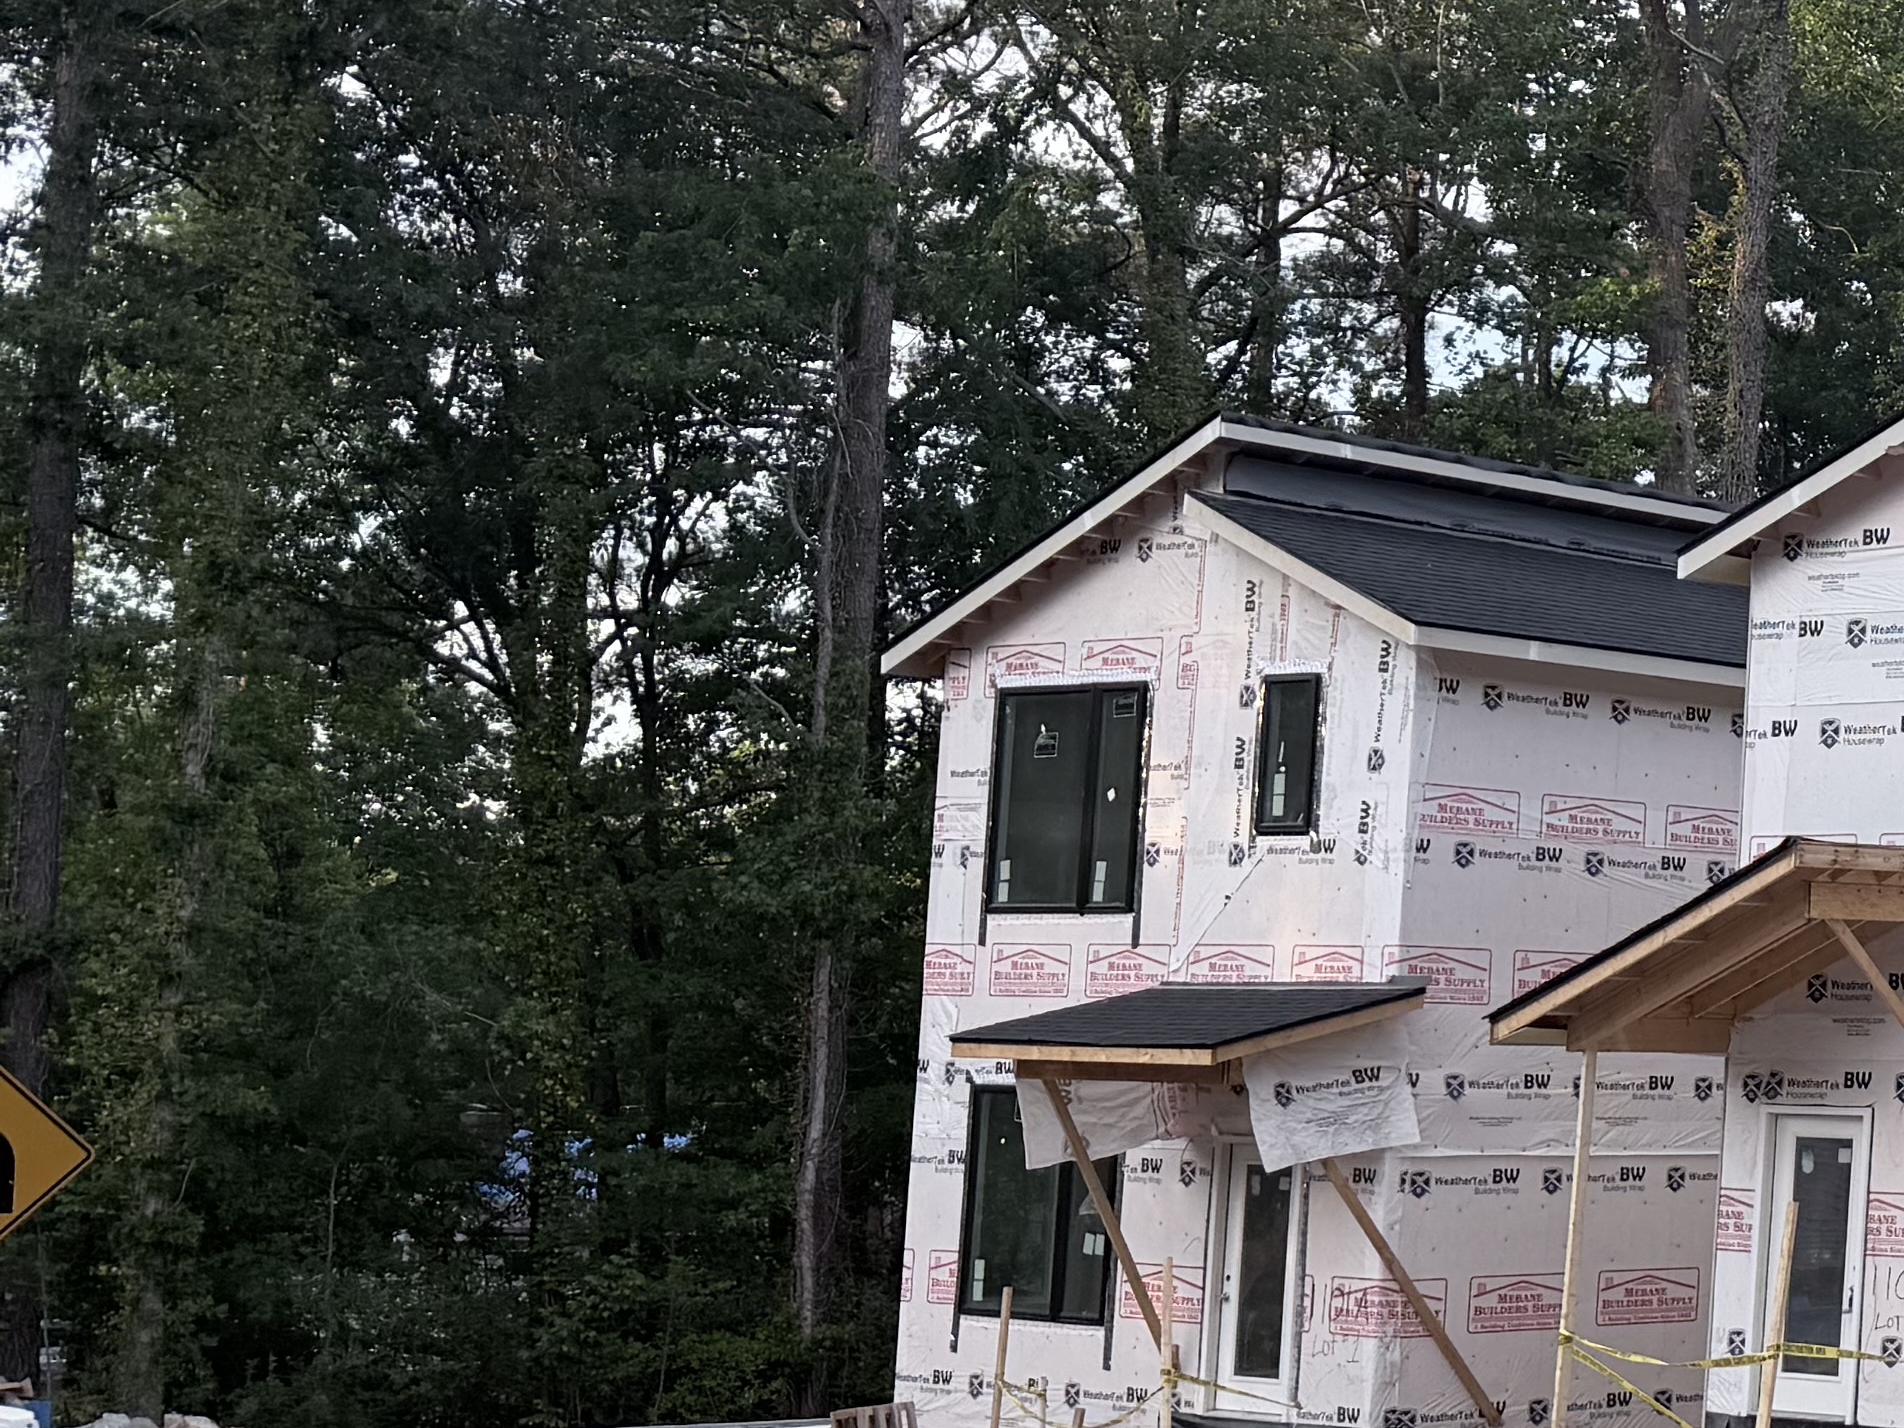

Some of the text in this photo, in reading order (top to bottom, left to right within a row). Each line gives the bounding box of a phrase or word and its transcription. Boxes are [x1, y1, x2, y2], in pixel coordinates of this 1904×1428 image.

[1805, 527, 1890, 549] WeatherTek BW
[1244, 579, 1257, 613] BW
[1798, 619, 1824, 638] BW
[1378, 639, 1392, 674] BW
[1562, 691, 1590, 709] BW
[1686, 706, 1711, 723] BW
[1771, 719, 1798, 738] BW
[1843, 724, 1897, 737] WeatherTek
[1233, 736, 1246, 771] BW
[1357, 800, 1371, 835] BW
[1602, 826, 1640, 840] SUPPLY
[1670, 832, 1718, 846] BUILDERS
[1535, 846, 1563, 863] BW
[1660, 855, 1687, 872] BW
[1444, 976, 1486, 989] SUPPLY
[1352, 1066, 1382, 1085] BW
[1523, 1073, 1551, 1090] BW
[1648, 1075, 1674, 1091] BW
[1787, 1071, 1872, 1091] WeatherTek BW
[1140, 1157, 1163, 1174] BW
[1619, 1166, 1646, 1182] BW
[1352, 1167, 1377, 1184] BW
[1434, 1167, 1520, 1186] WeatherTek BW
[1497, 1292, 1543, 1305] MEBANE
[1623, 1286, 1667, 1298] MEBANE
[1473, 1304, 1529, 1317] BUILDERS
[1602, 1295, 1694, 1310] BUILDERS SUPPLY
[1875, 1312, 1903, 1331] LOT
[932, 1369, 953, 1384] BW
[1126, 1386, 1148, 1402] BW
[1606, 1391, 1633, 1408] BW
[1337, 1406, 1361, 1423] BW
[1420, 1412, 1475, 1424] WeatherTek
